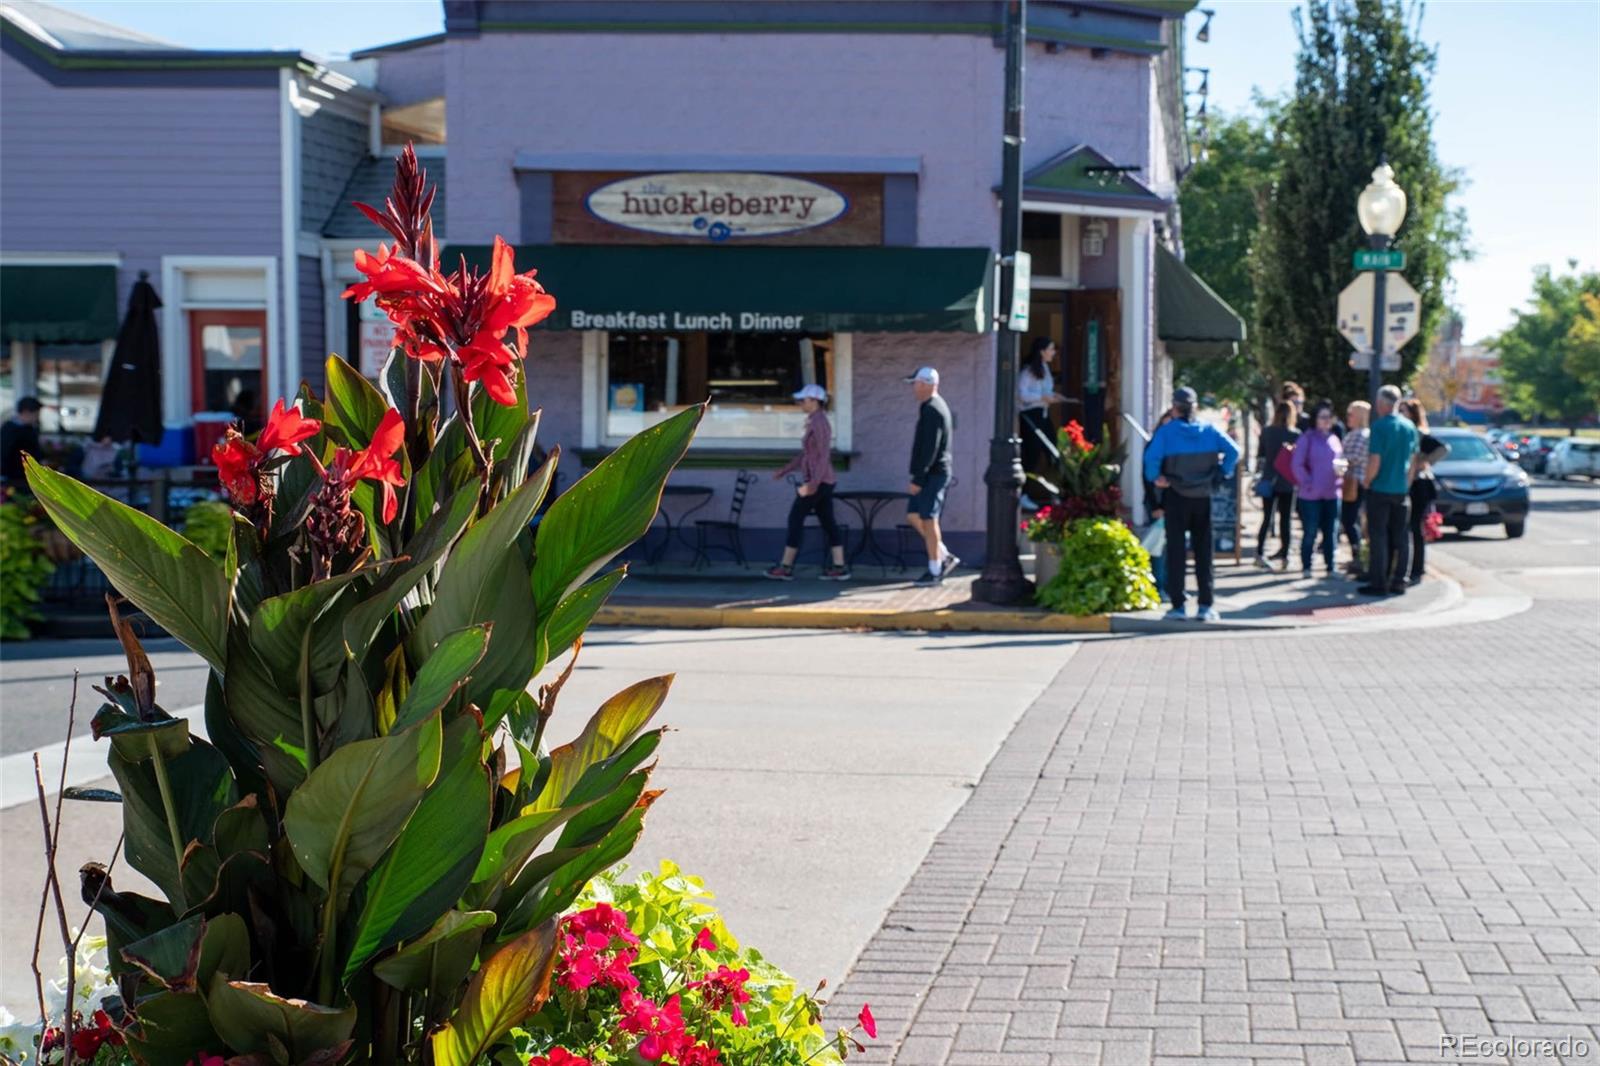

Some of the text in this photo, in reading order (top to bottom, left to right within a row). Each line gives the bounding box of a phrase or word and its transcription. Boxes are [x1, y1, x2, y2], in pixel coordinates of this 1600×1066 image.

[642, 182, 666, 195] the
[621, 189, 817, 219] huckleberry
[570, 310, 667, 329] Breakfast
[673, 312, 733, 330] Lunch
[740, 313, 804, 330] Dinner
